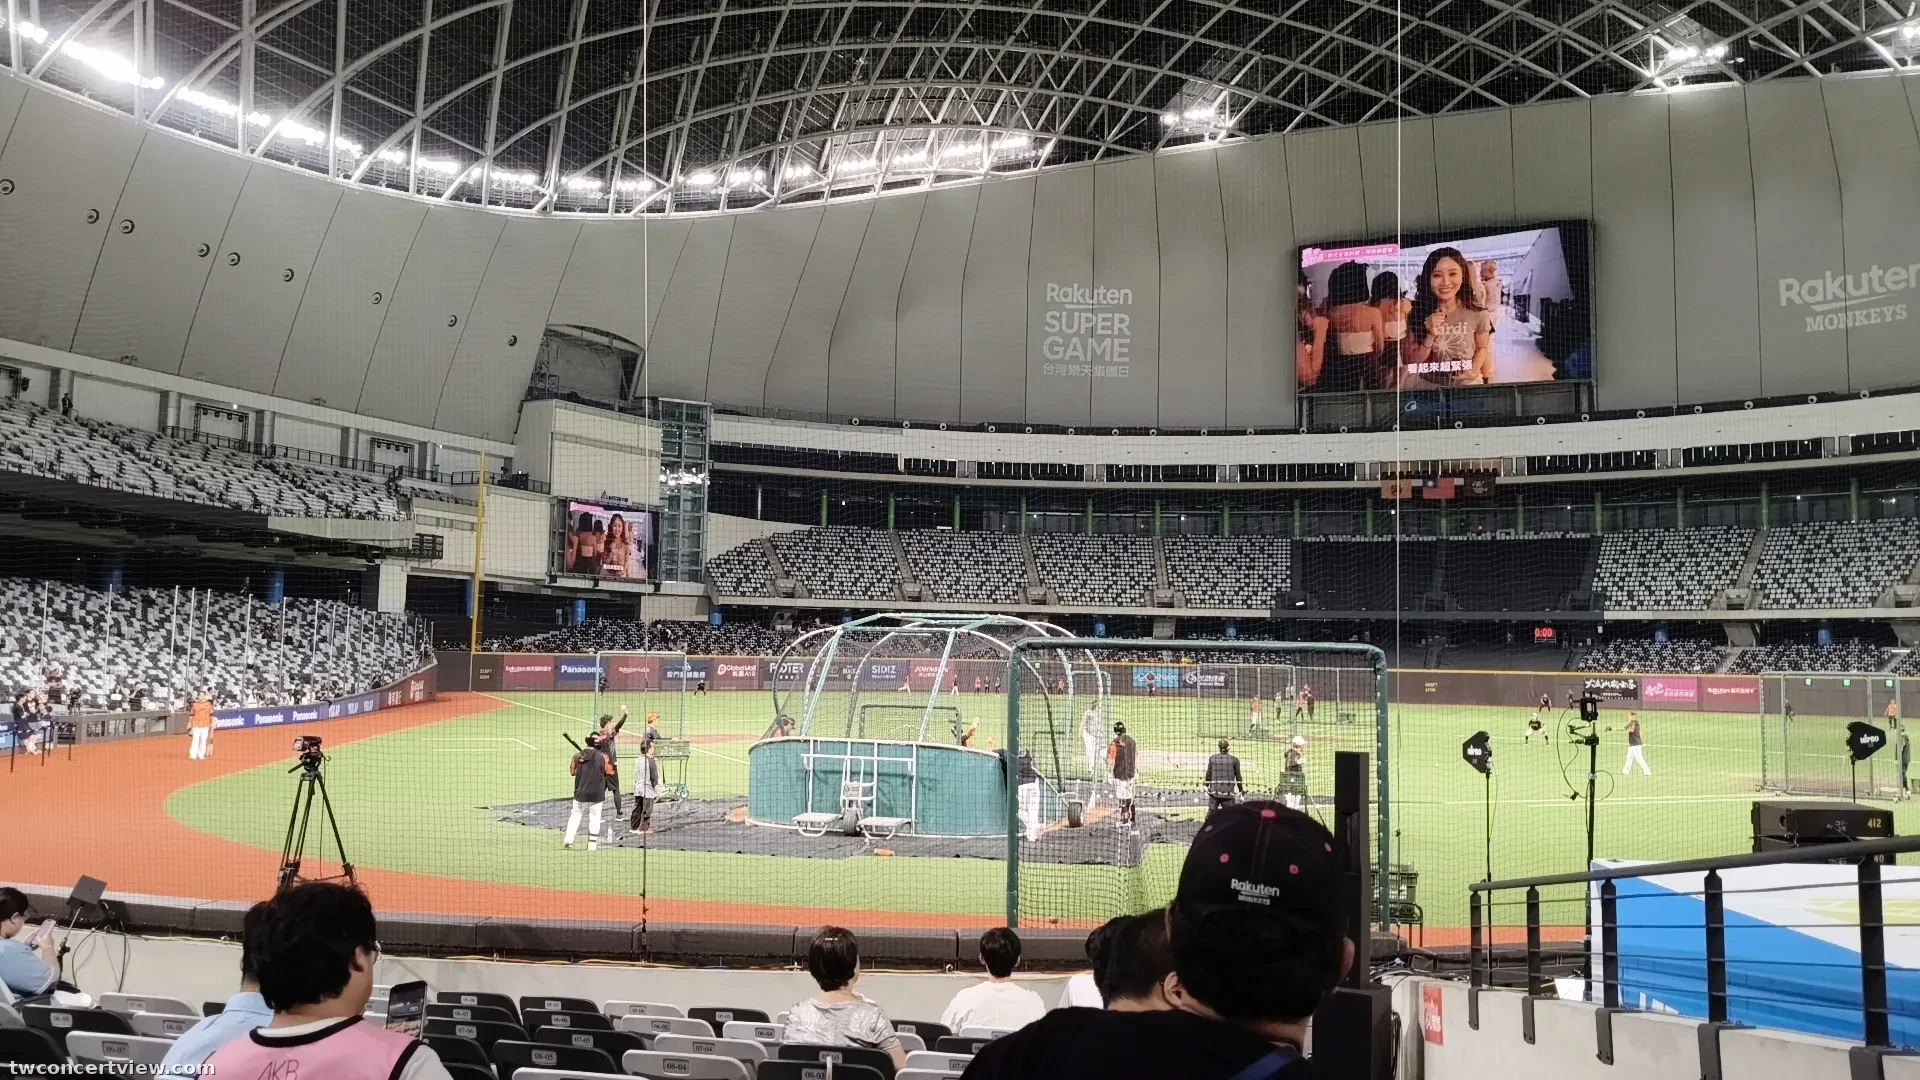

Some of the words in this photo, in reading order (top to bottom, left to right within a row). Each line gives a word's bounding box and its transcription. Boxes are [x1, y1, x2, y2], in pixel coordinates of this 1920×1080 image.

[1046, 283, 1132, 304] Rakuten
[1044, 311, 1131, 335] SUPER
[1805, 304, 1908, 333] MONKEYS
[1438, 322, 1468, 335] ardi
[1043, 336, 1130, 362] GAME
[1408, 360, 1473, 374] 看起來超緊張
[1534, 628, 1553, 637] 0:00
[561, 664, 604, 673] Panasonc
[871, 665, 897, 674] SIDIZ
[213, 715, 244, 728] Panasonic
[254, 712, 283, 724] Panasonic
[292, 710, 318, 721] Panasonic
[1867, 818, 1881, 828] 412
[1230, 878, 1280, 897] Rakuten
[574, 1036, 591, 1044] 07-05
[534, 1053, 554, 1061] 08-05
[666, 1061, 687, 1071] 08-04
